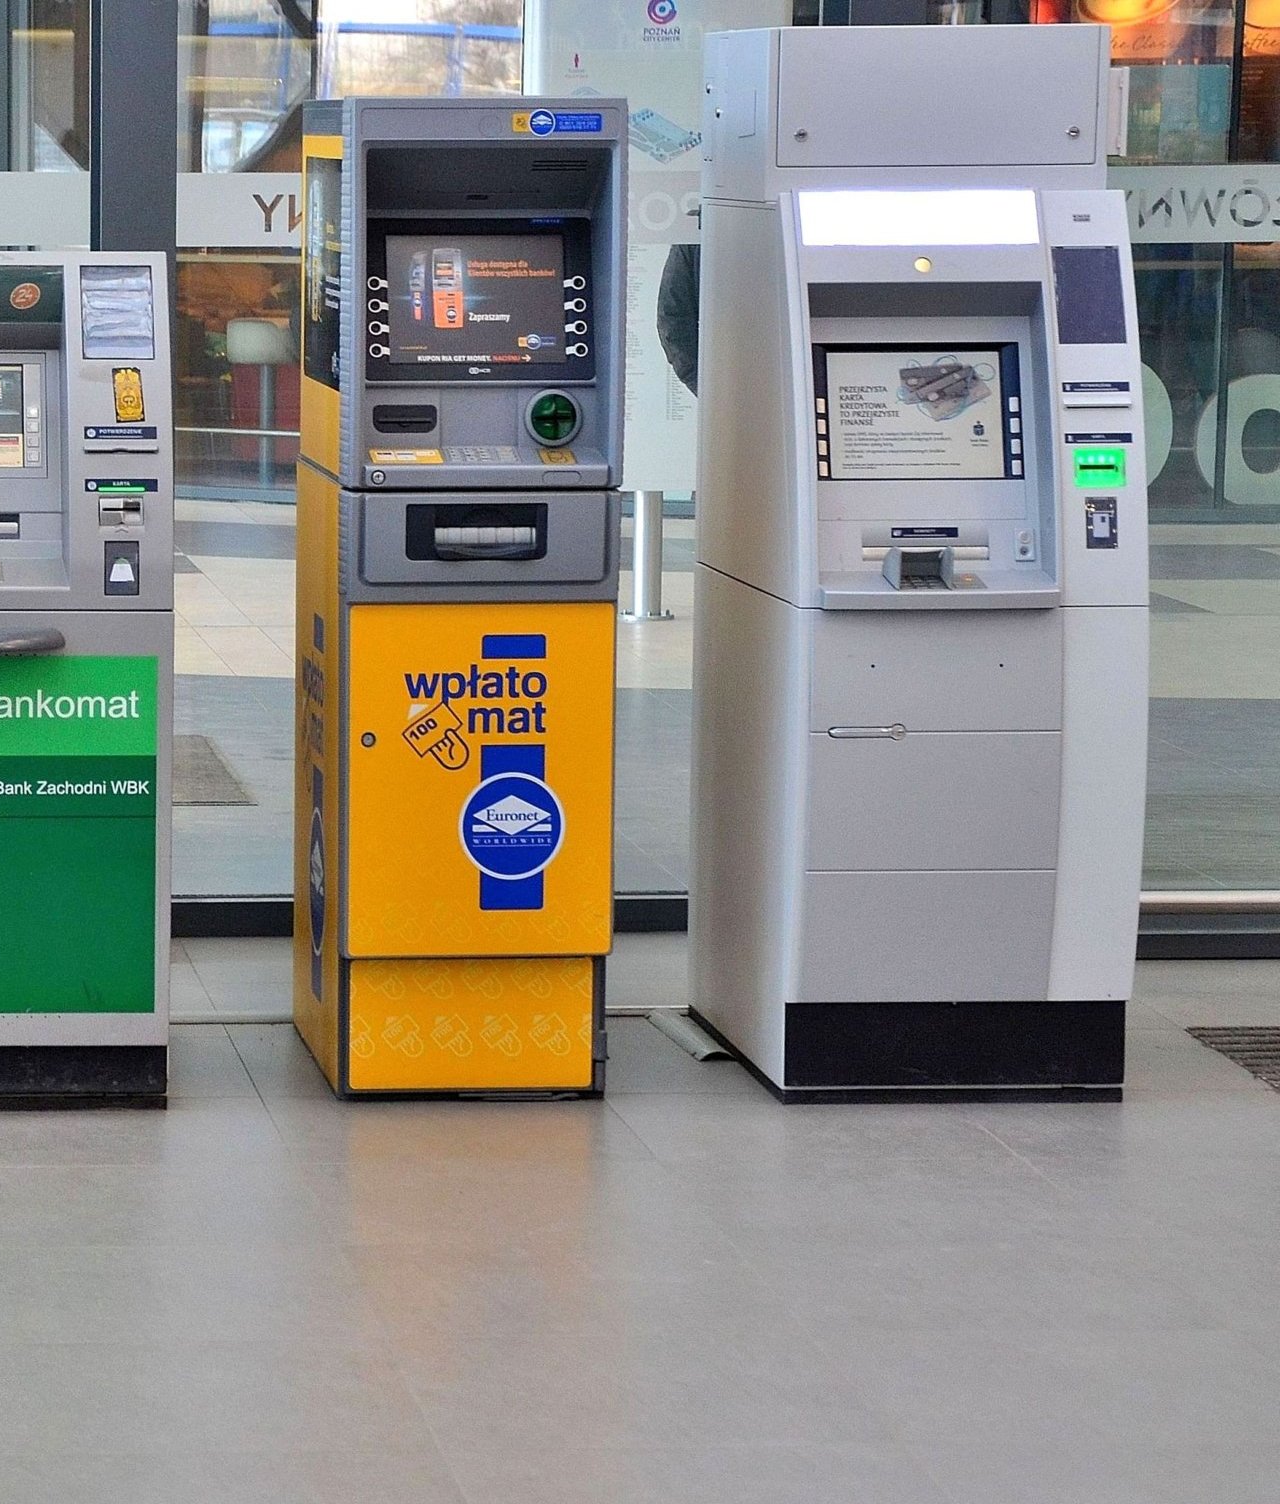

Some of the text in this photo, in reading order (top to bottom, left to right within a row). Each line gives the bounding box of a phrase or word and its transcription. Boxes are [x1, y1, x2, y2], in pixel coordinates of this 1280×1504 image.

[643, 26, 681, 36] POZNAŃ
[468, 312, 511, 323] Zapraszamy
[839, 386, 888, 394] PRZEJRZYSTA
[839, 402, 887, 410] KREDYTOWA
[840, 410, 900, 419] TO PRZEJRZYSTE
[840, 418, 874, 426] FINANSE
[404, 664, 547, 704] wpłato
[467, 703, 547, 734] mat
[409, 717, 439, 742] 100
[36, 781, 107, 795] Zachodni
[110, 781, 150, 795] WBK
[485, 808, 540, 823] Euronet
[472, 837, 553, 845] WORLDWIDE
